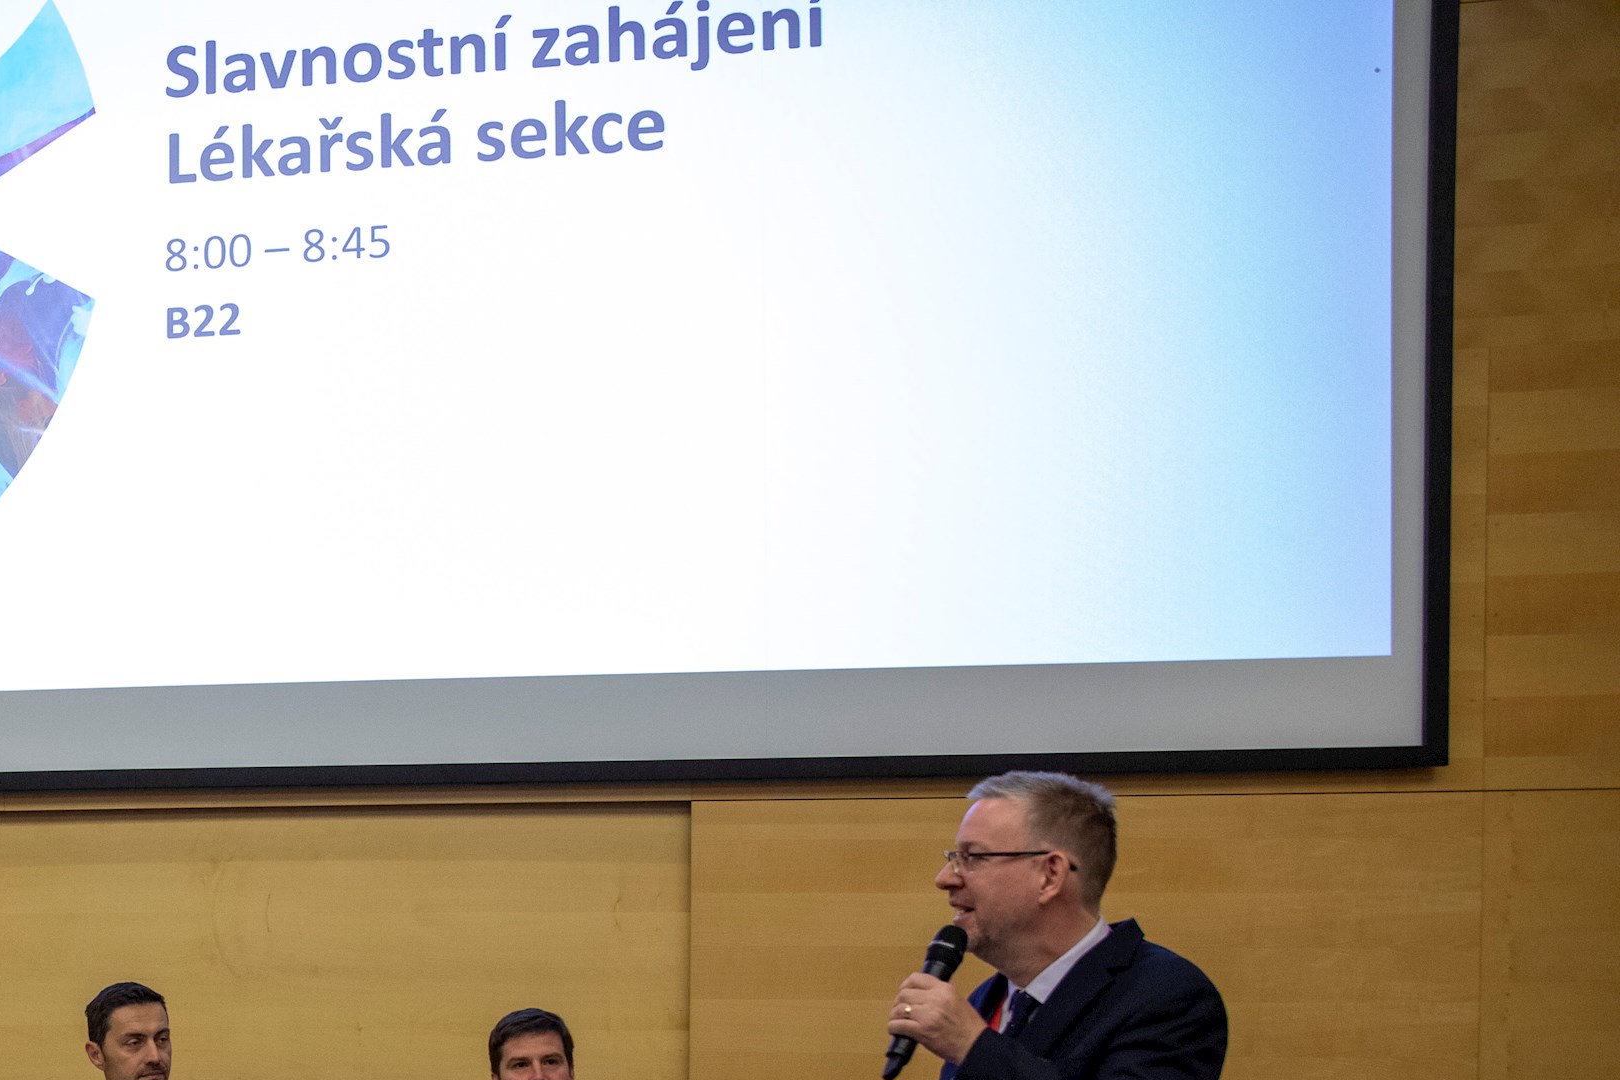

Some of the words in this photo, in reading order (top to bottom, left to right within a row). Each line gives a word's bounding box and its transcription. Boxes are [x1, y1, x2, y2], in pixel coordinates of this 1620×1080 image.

[165, 14, 513, 99] Slavnostní
[531, 0, 823, 72] zahájení
[168, 108, 452, 185] Lékařská
[476, 99, 667, 162] sekce
[165, 233, 253, 273] 8:00
[303, 224, 391, 264] 8:45
[165, 302, 242, 340] B22
